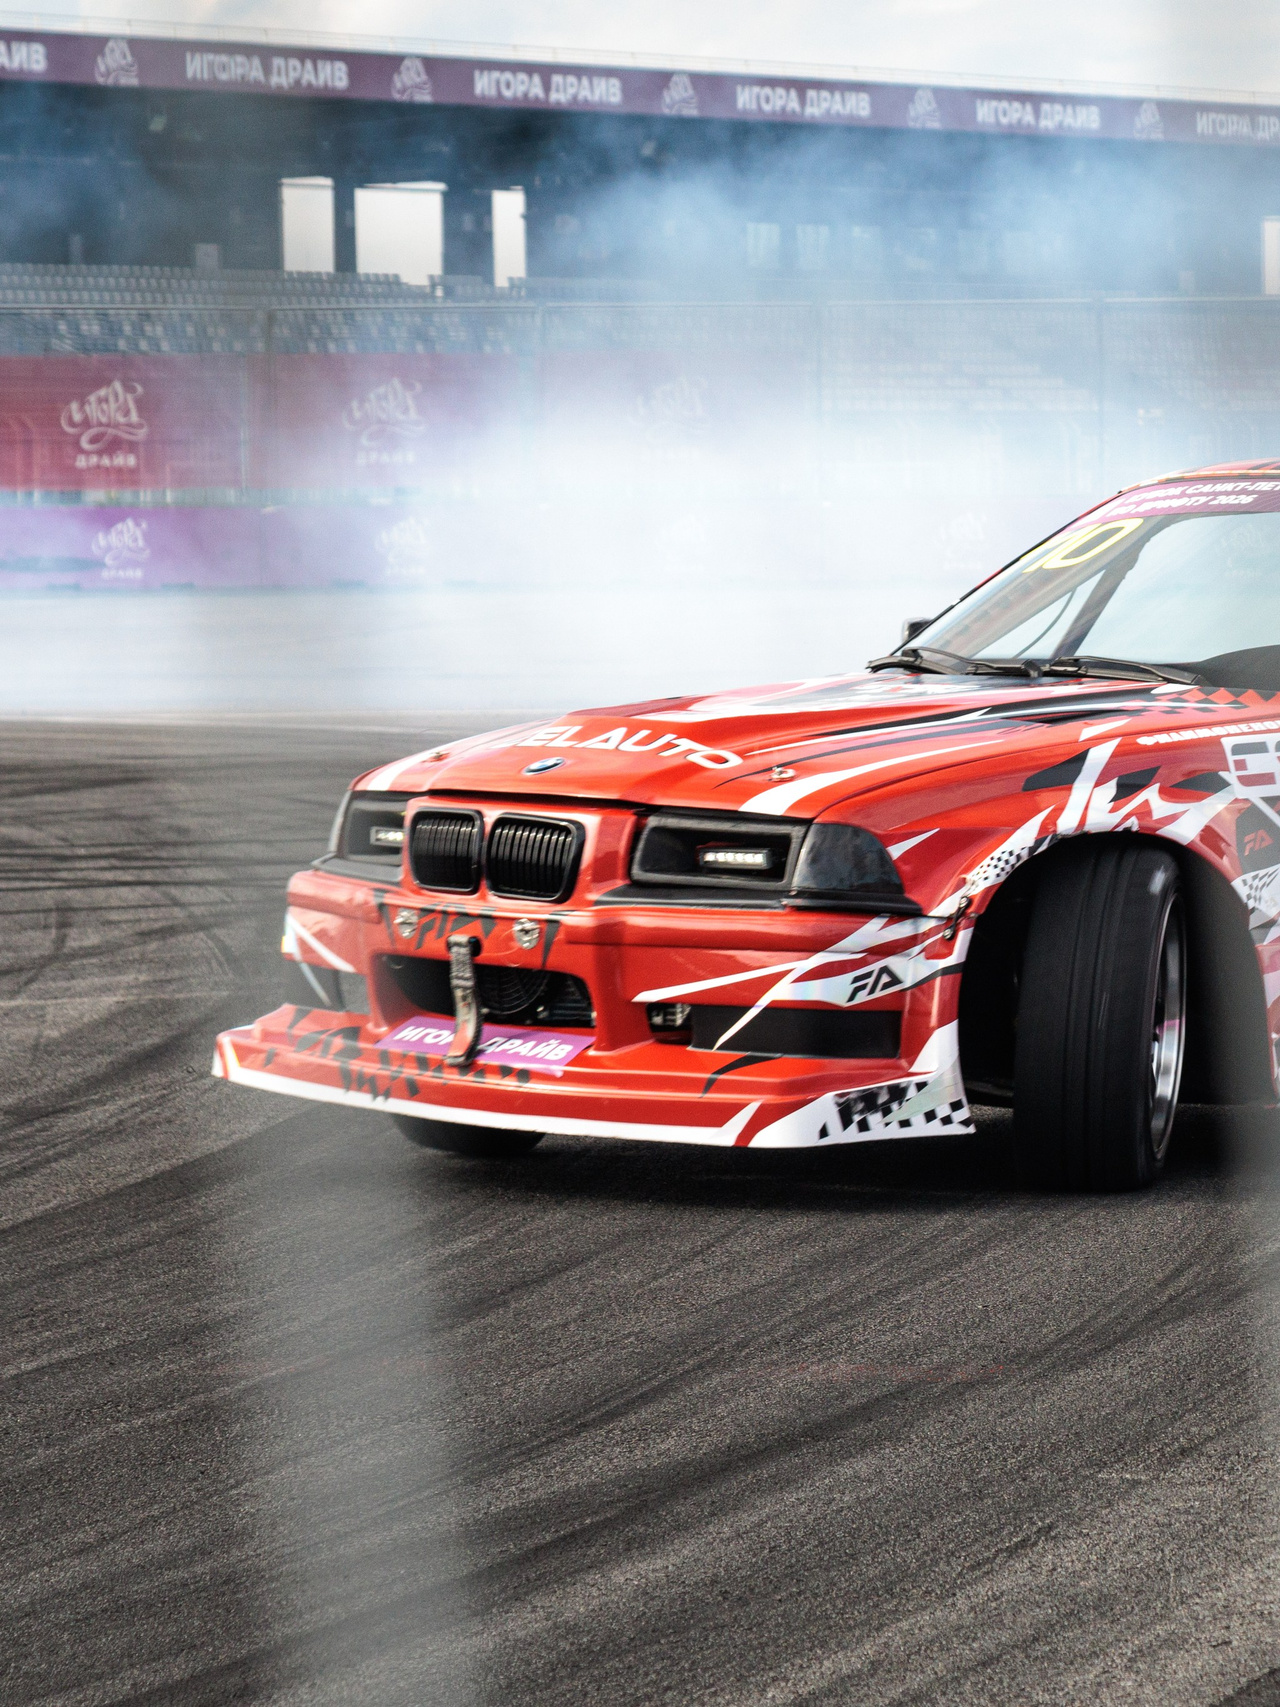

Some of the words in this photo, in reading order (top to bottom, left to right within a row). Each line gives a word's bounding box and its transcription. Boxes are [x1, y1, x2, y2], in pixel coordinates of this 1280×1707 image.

[0, 40, 48, 73] АЙВ
[186, 51, 265, 82] ИГОРА
[474, 69, 543, 99] ИГОРА
[737, 84, 801, 112] ИГОРА
[976, 99, 1036, 126] ИГОРА
[1196, 111, 1254, 137] ИГОРА
[393, 1025, 456, 1047] ИГОР
[478, 1036, 575, 1061] ДРАЙВ
